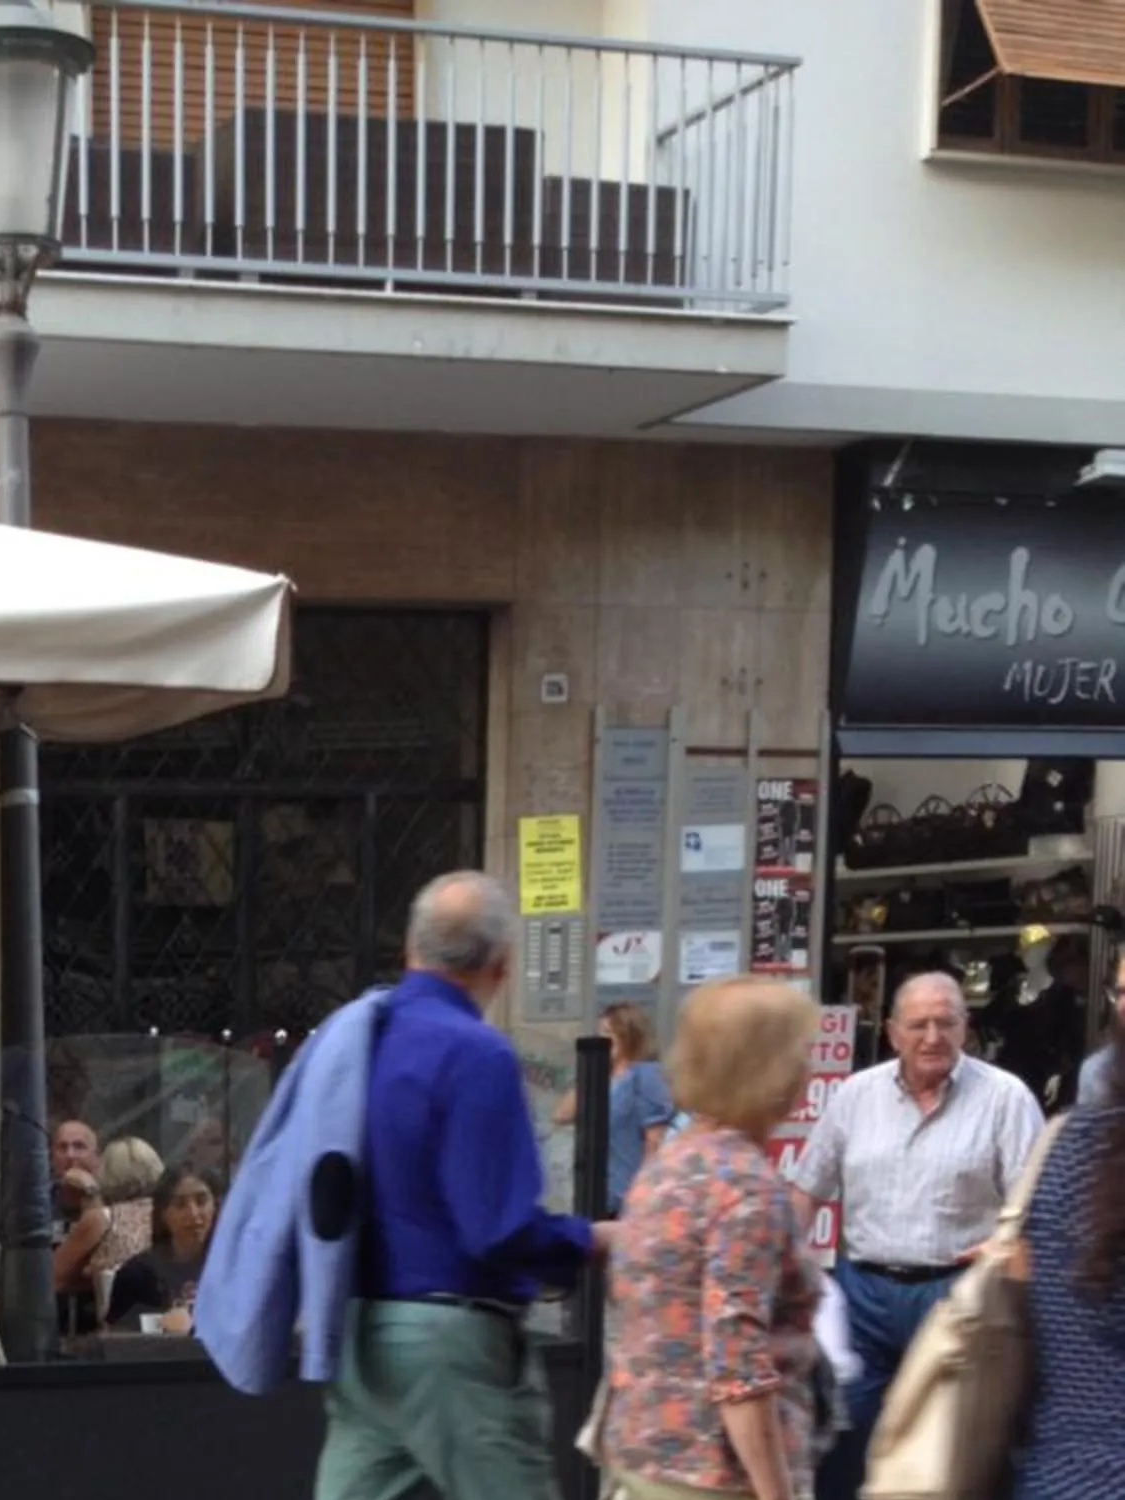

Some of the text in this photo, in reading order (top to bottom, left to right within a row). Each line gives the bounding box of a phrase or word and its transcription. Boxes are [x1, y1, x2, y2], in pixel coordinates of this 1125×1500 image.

[869, 537, 1073, 646] Mucho
[1003, 657, 1118, 705] MUJER
[757, 780, 794, 800] ONE
[755, 879, 789, 897] ONE
